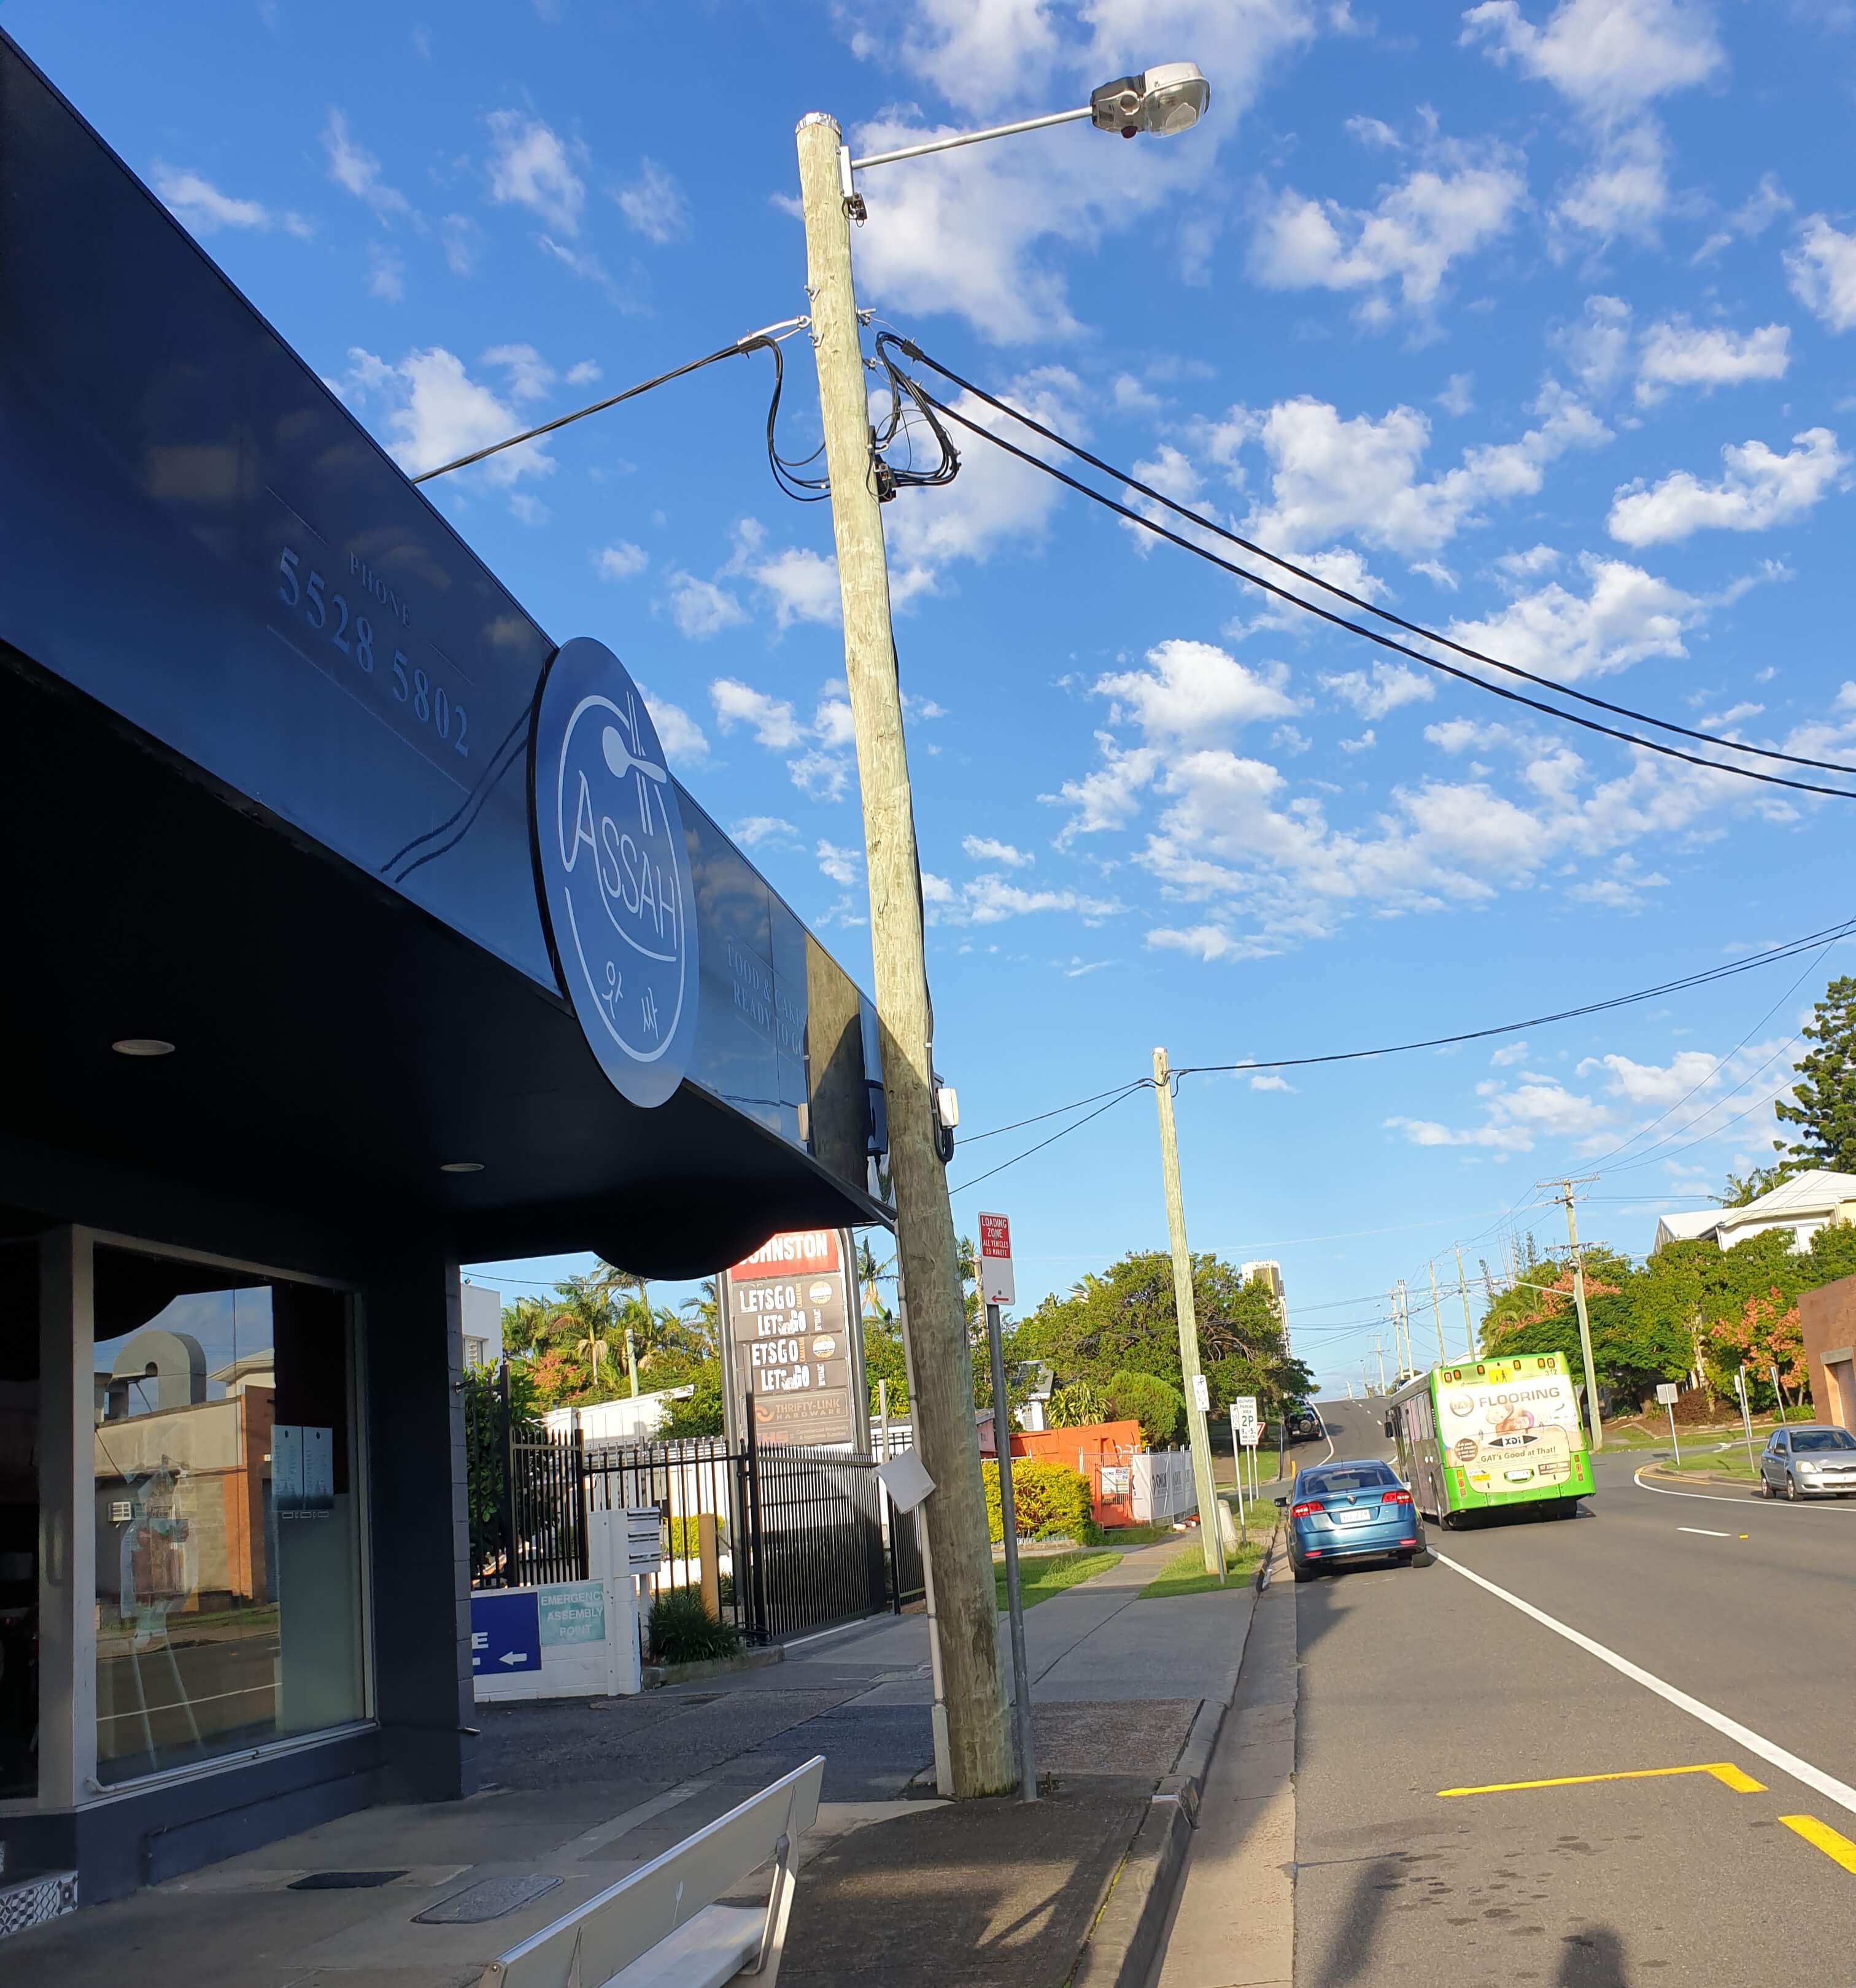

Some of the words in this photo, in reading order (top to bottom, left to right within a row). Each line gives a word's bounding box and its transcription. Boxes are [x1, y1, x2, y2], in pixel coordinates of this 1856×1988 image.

[349, 551, 411, 629] PHONE
[279, 546, 374, 673] 5528
[392, 649, 468, 757] 5802
[566, 770, 677, 950] ASSAH
[728, 942, 759, 991] FOOD
[764, 978, 771, 1002] &
[733, 980, 771, 1032] READY
[775, 1016, 789, 1046] TO
[981, 1217, 1007, 1229] LOADING
[987, 1228, 1003, 1238] ZONE
[740, 1233, 828, 1266] HNSTON
[991, 1240, 1009, 1248] VEHICLES
[992, 1248, 1007, 1257] MINUTE
[751, 1338, 798, 1366] ETSGO
[1479, 1387, 1560, 1407] FLOORING
[776, 1399, 840, 1414] THRIFTY-LINK
[776, 1408, 841, 1420] HARDWARE
[1242, 1415, 1254, 1427] 2P
[1504, 1450, 1525, 1459] Good
[1536, 1446, 1556, 1455] That!
[541, 1590, 604, 1606] EMERGENCY
[547, 1606, 604, 1622] ASSEMBLY
[559, 1625, 592, 1637] POINT
